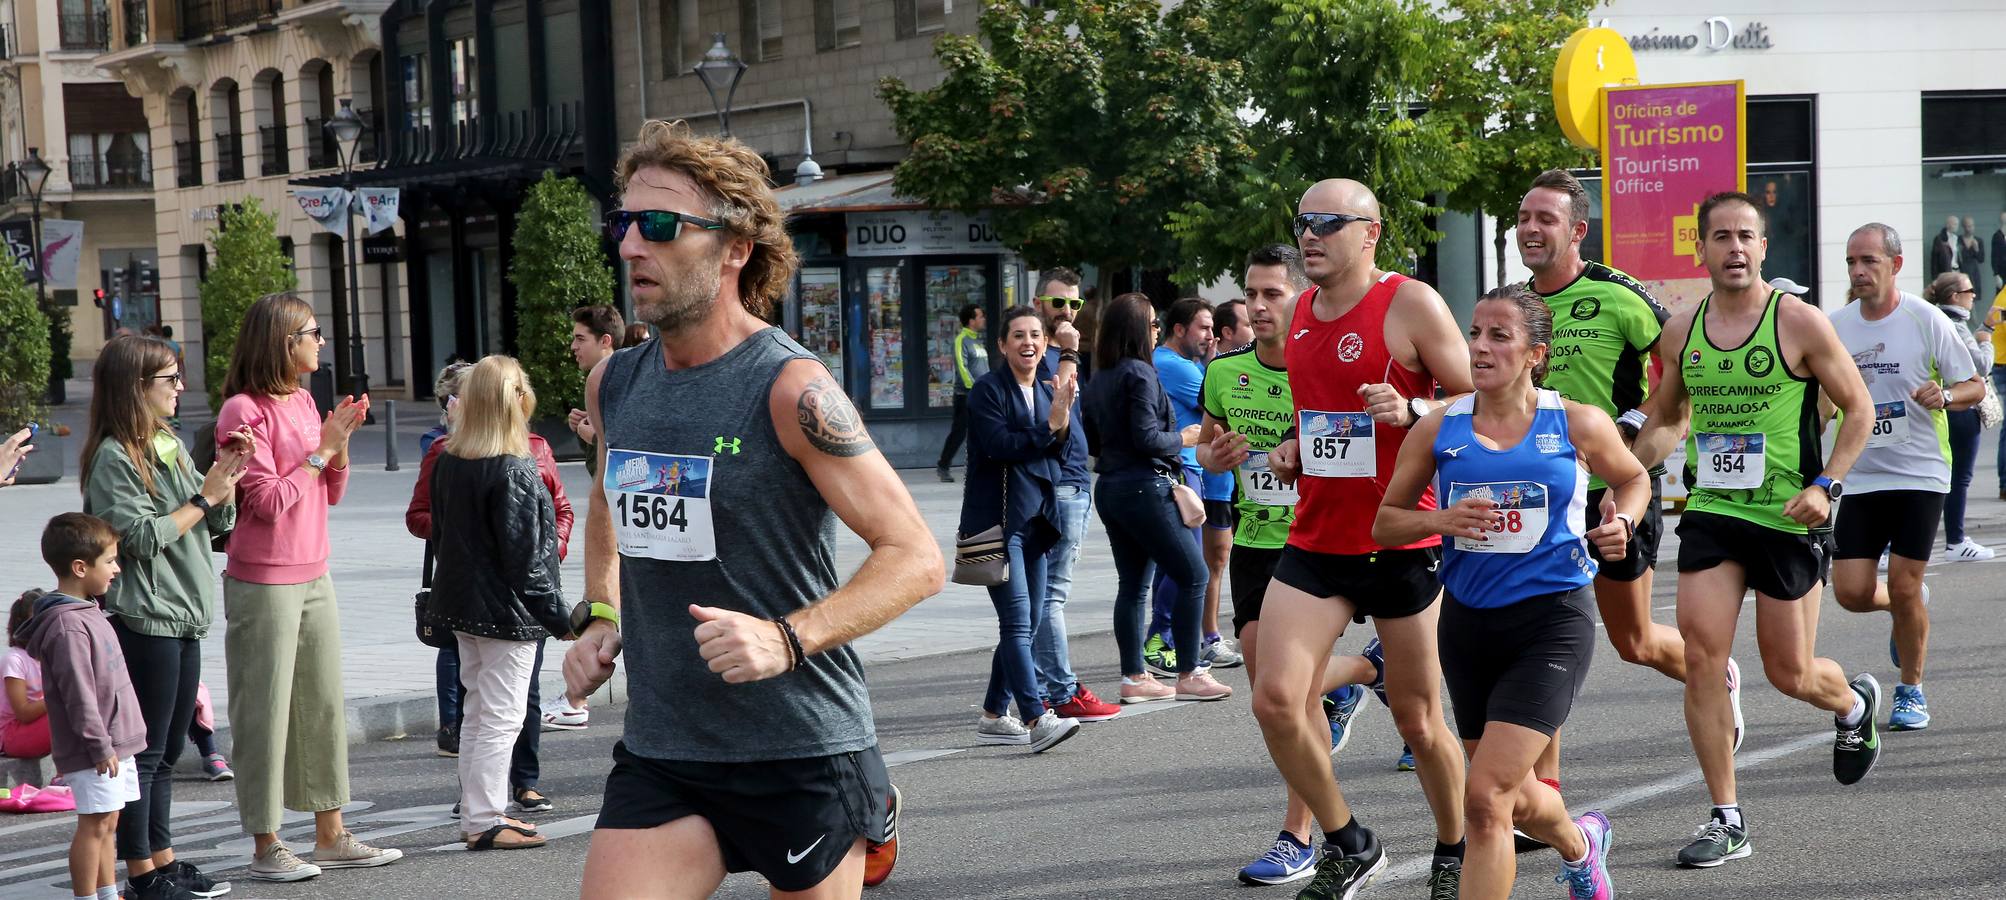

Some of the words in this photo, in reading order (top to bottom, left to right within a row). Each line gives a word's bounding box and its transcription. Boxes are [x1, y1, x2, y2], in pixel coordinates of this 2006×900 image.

[1703, 16, 1775, 53] Dutti
[1614, 102, 1673, 120] Oficina
[1677, 99, 1698, 116] de
[1614, 121, 1725, 148] Turismo
[1614, 154, 1700, 176] Tourism
[1615, 178, 1665, 195] Office
[857, 224, 906, 245] DUO
[1678, 227, 1698, 242] 50
[1694, 401, 1770, 415] CARBAJOSA
[1707, 420, 1756, 428] SALAMANCA
[1312, 437, 1351, 460] 857
[1712, 454, 1746, 473] 954
[616, 492, 688, 533] 1564
